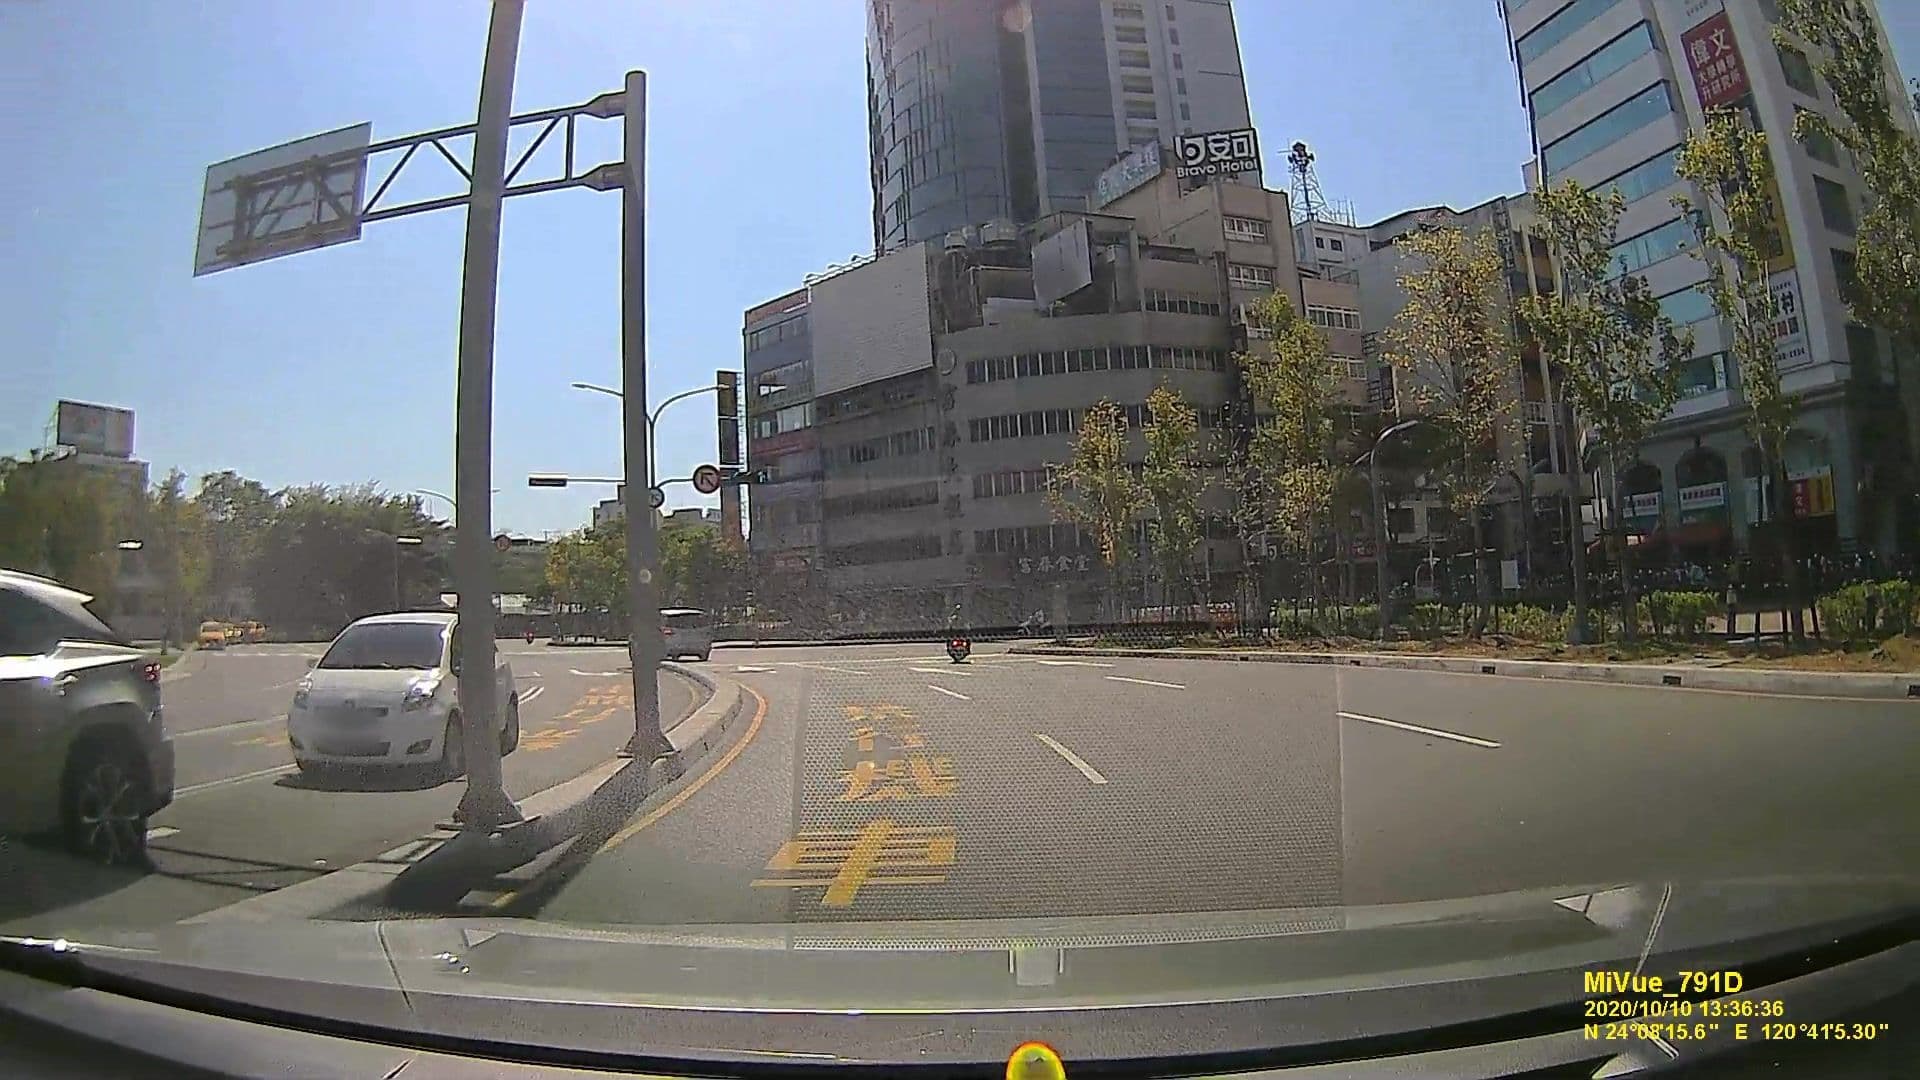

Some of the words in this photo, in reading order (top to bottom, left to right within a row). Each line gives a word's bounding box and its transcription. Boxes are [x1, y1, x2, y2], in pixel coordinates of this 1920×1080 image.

[1691, 28, 1731, 68] 偉文
[1177, 164, 1216, 178] Bravo
[1221, 158, 1258, 172] Hotel
